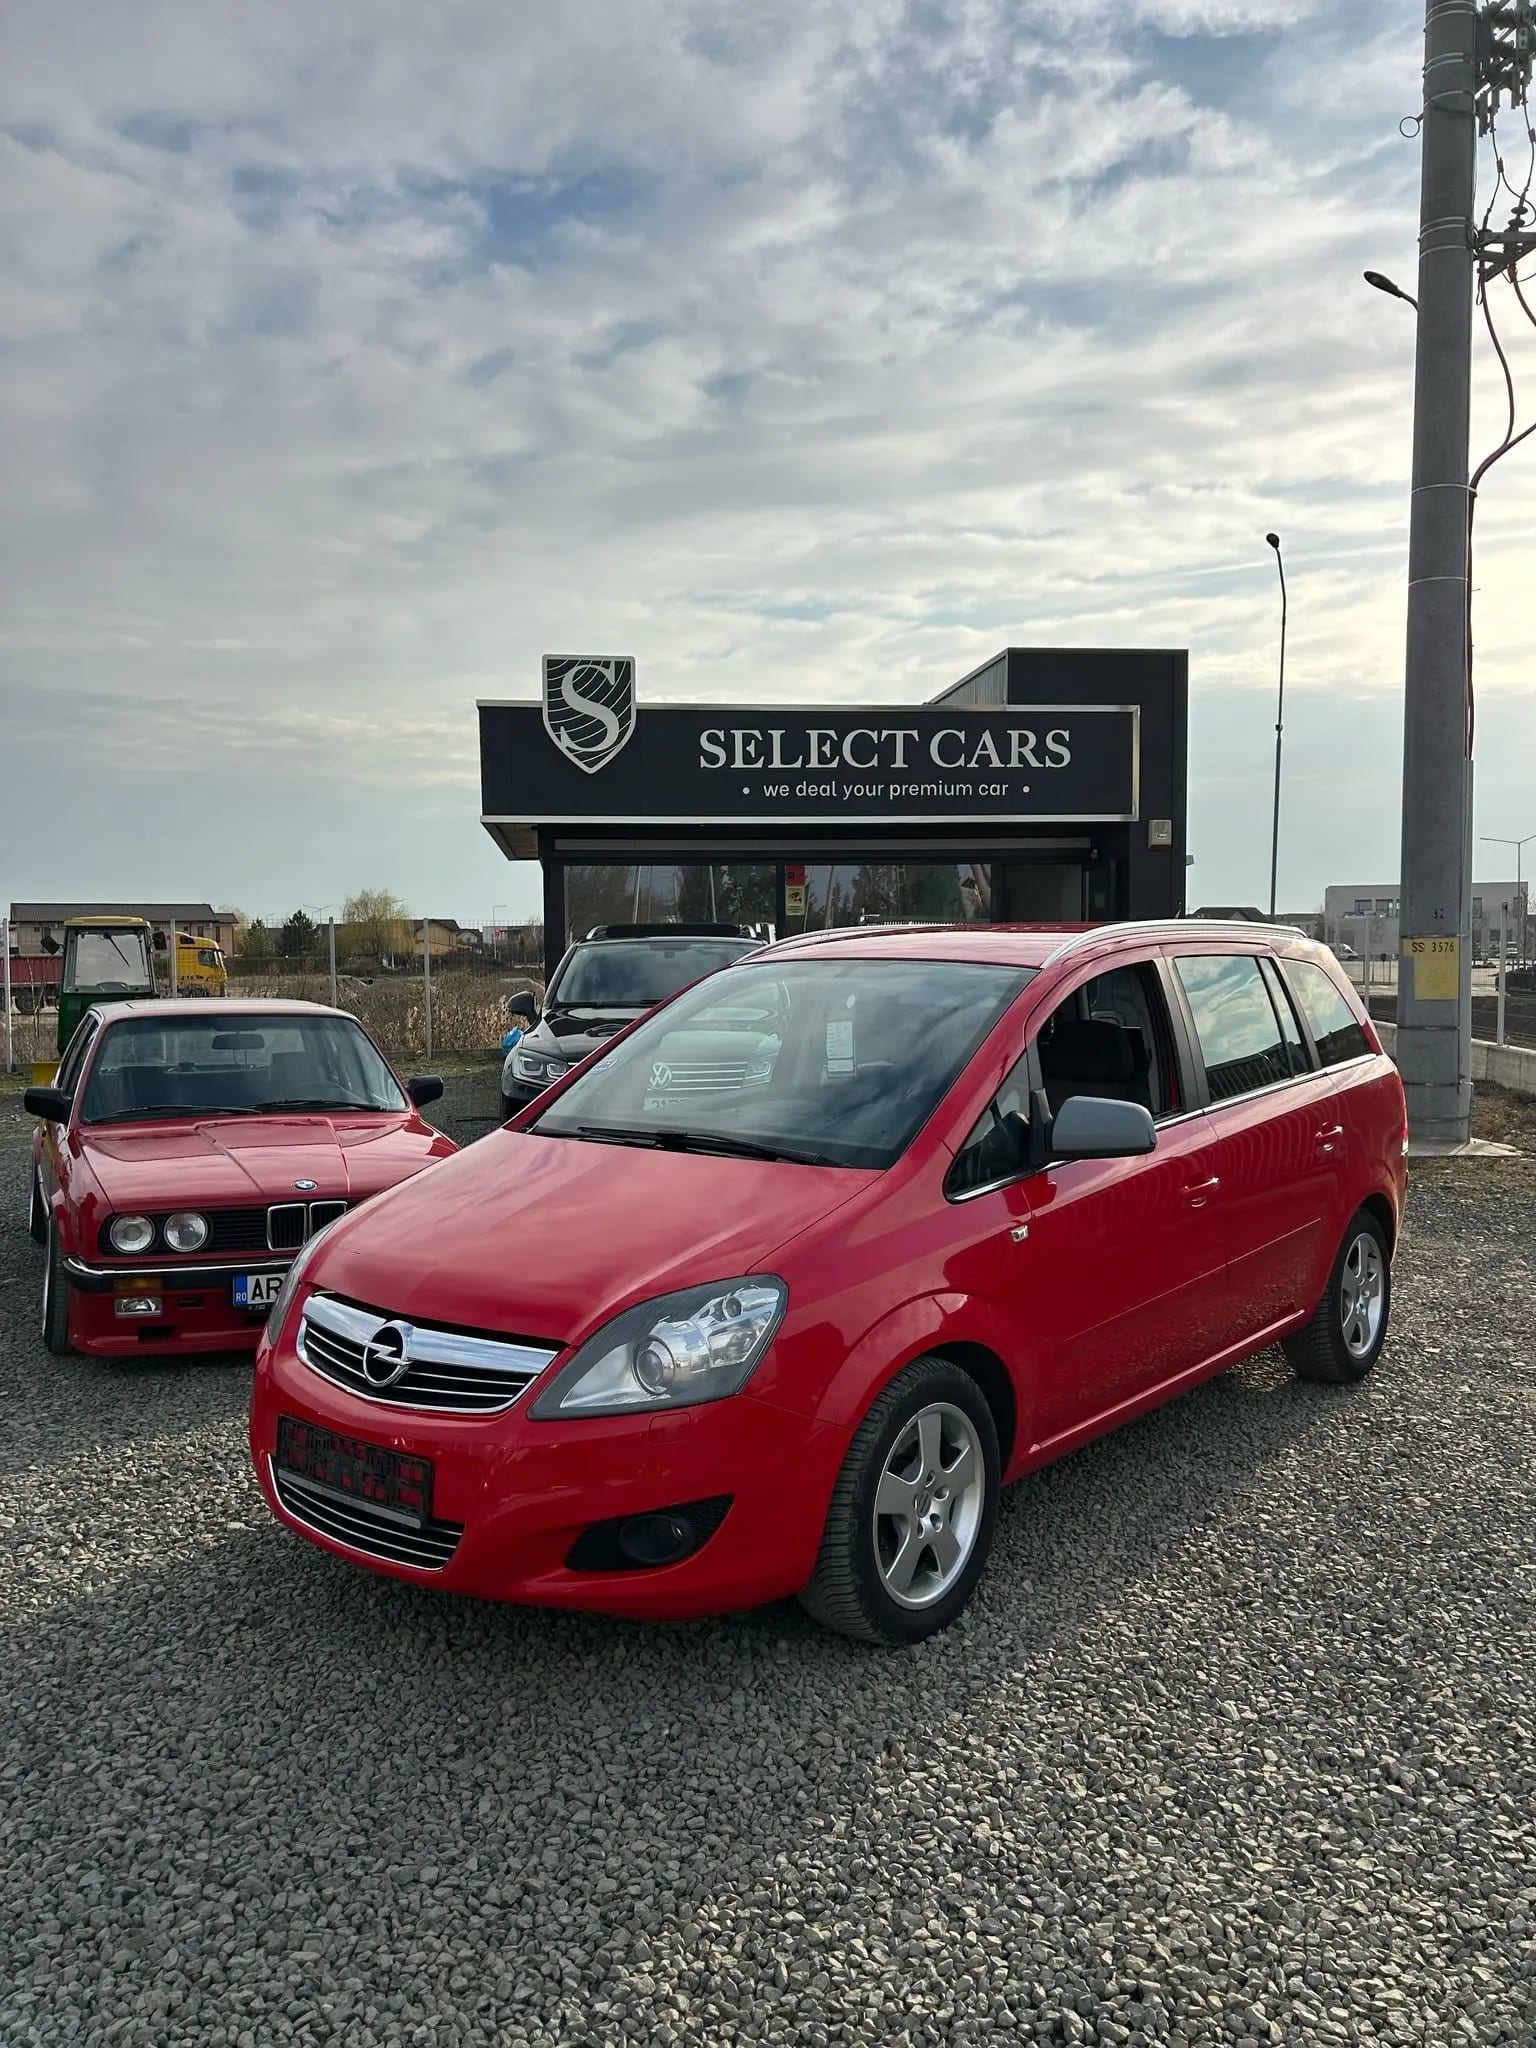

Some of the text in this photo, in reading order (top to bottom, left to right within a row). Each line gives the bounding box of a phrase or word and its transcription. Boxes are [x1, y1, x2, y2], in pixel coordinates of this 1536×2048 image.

[560, 660, 620, 752] S
[699, 729, 1072, 769] SELECT CARS
[762, 780, 1009, 801] we deal your premium car
[1411, 942, 1454, 952] SS 3576
[235, 1292, 247, 1302] RO
